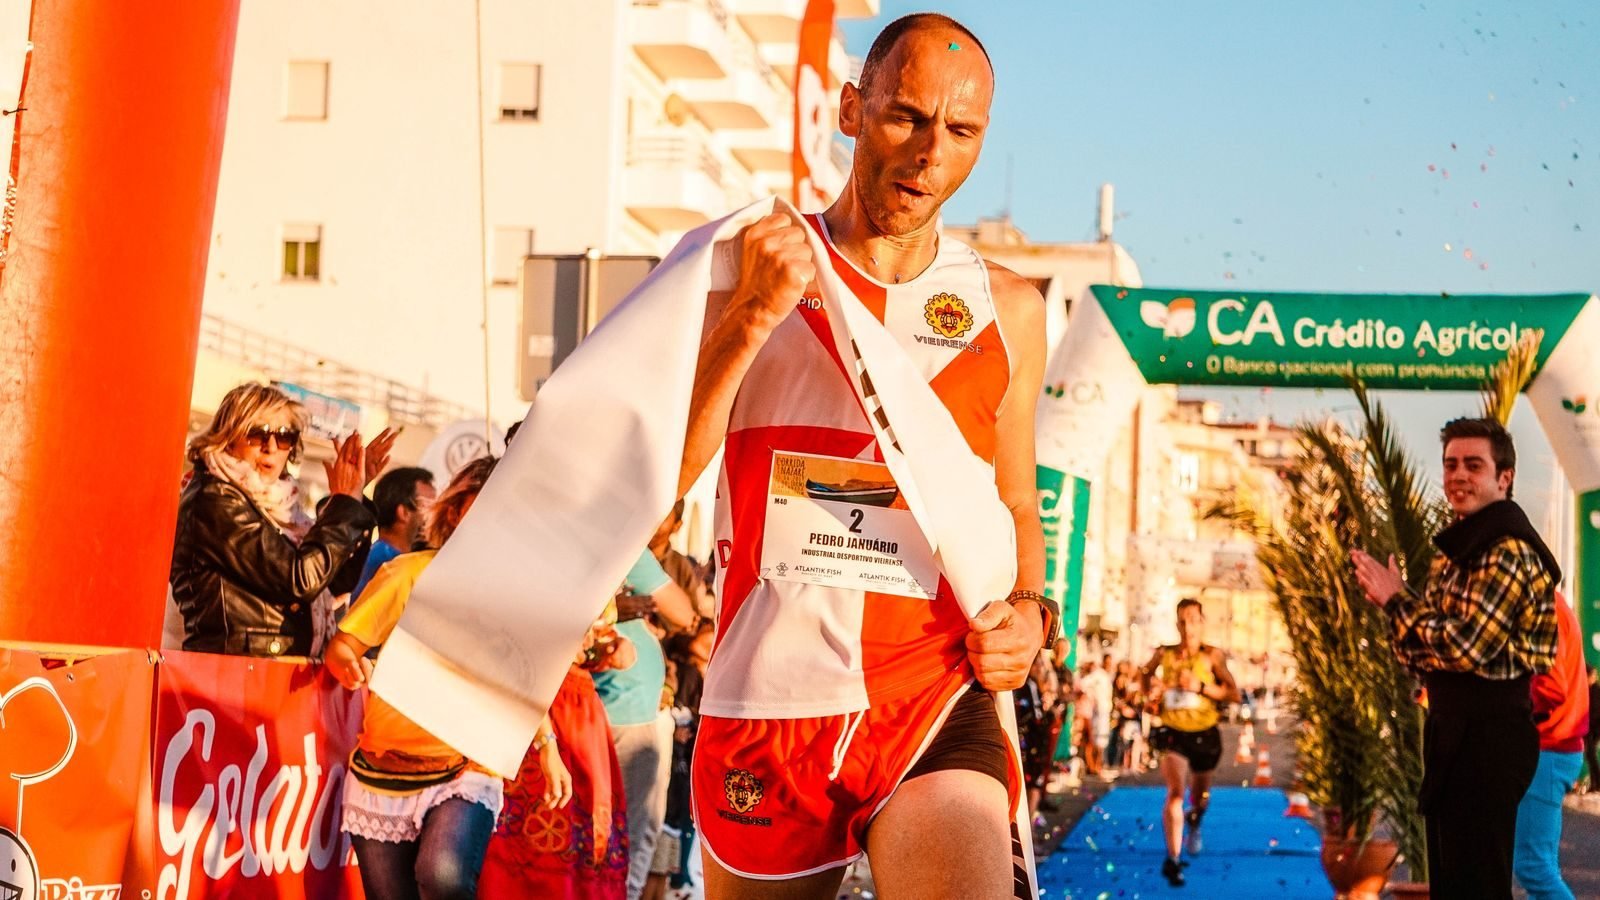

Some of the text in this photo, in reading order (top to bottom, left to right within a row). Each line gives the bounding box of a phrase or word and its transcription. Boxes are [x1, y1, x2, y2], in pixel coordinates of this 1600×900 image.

[1207, 300, 1285, 347] CA
[1294, 316, 1405, 349] Crédito
[913, 334, 983, 354] VIEIRENSE
[1356, 363, 1395, 377] com
[848, 508, 865, 533] 2
[809, 532, 898, 554] PEDRO JANUÁRIO
[801, 548, 903, 566] INDUSTRIAL DESPORTIVO VIEIRENSE
[794, 565, 825, 574] ATLANTIK
[826, 568, 842, 576] FISH
[859, 573, 890, 582] ATLANTIK
[891, 576, 906, 584] FISH
[158, 708, 345, 900] Gelato
